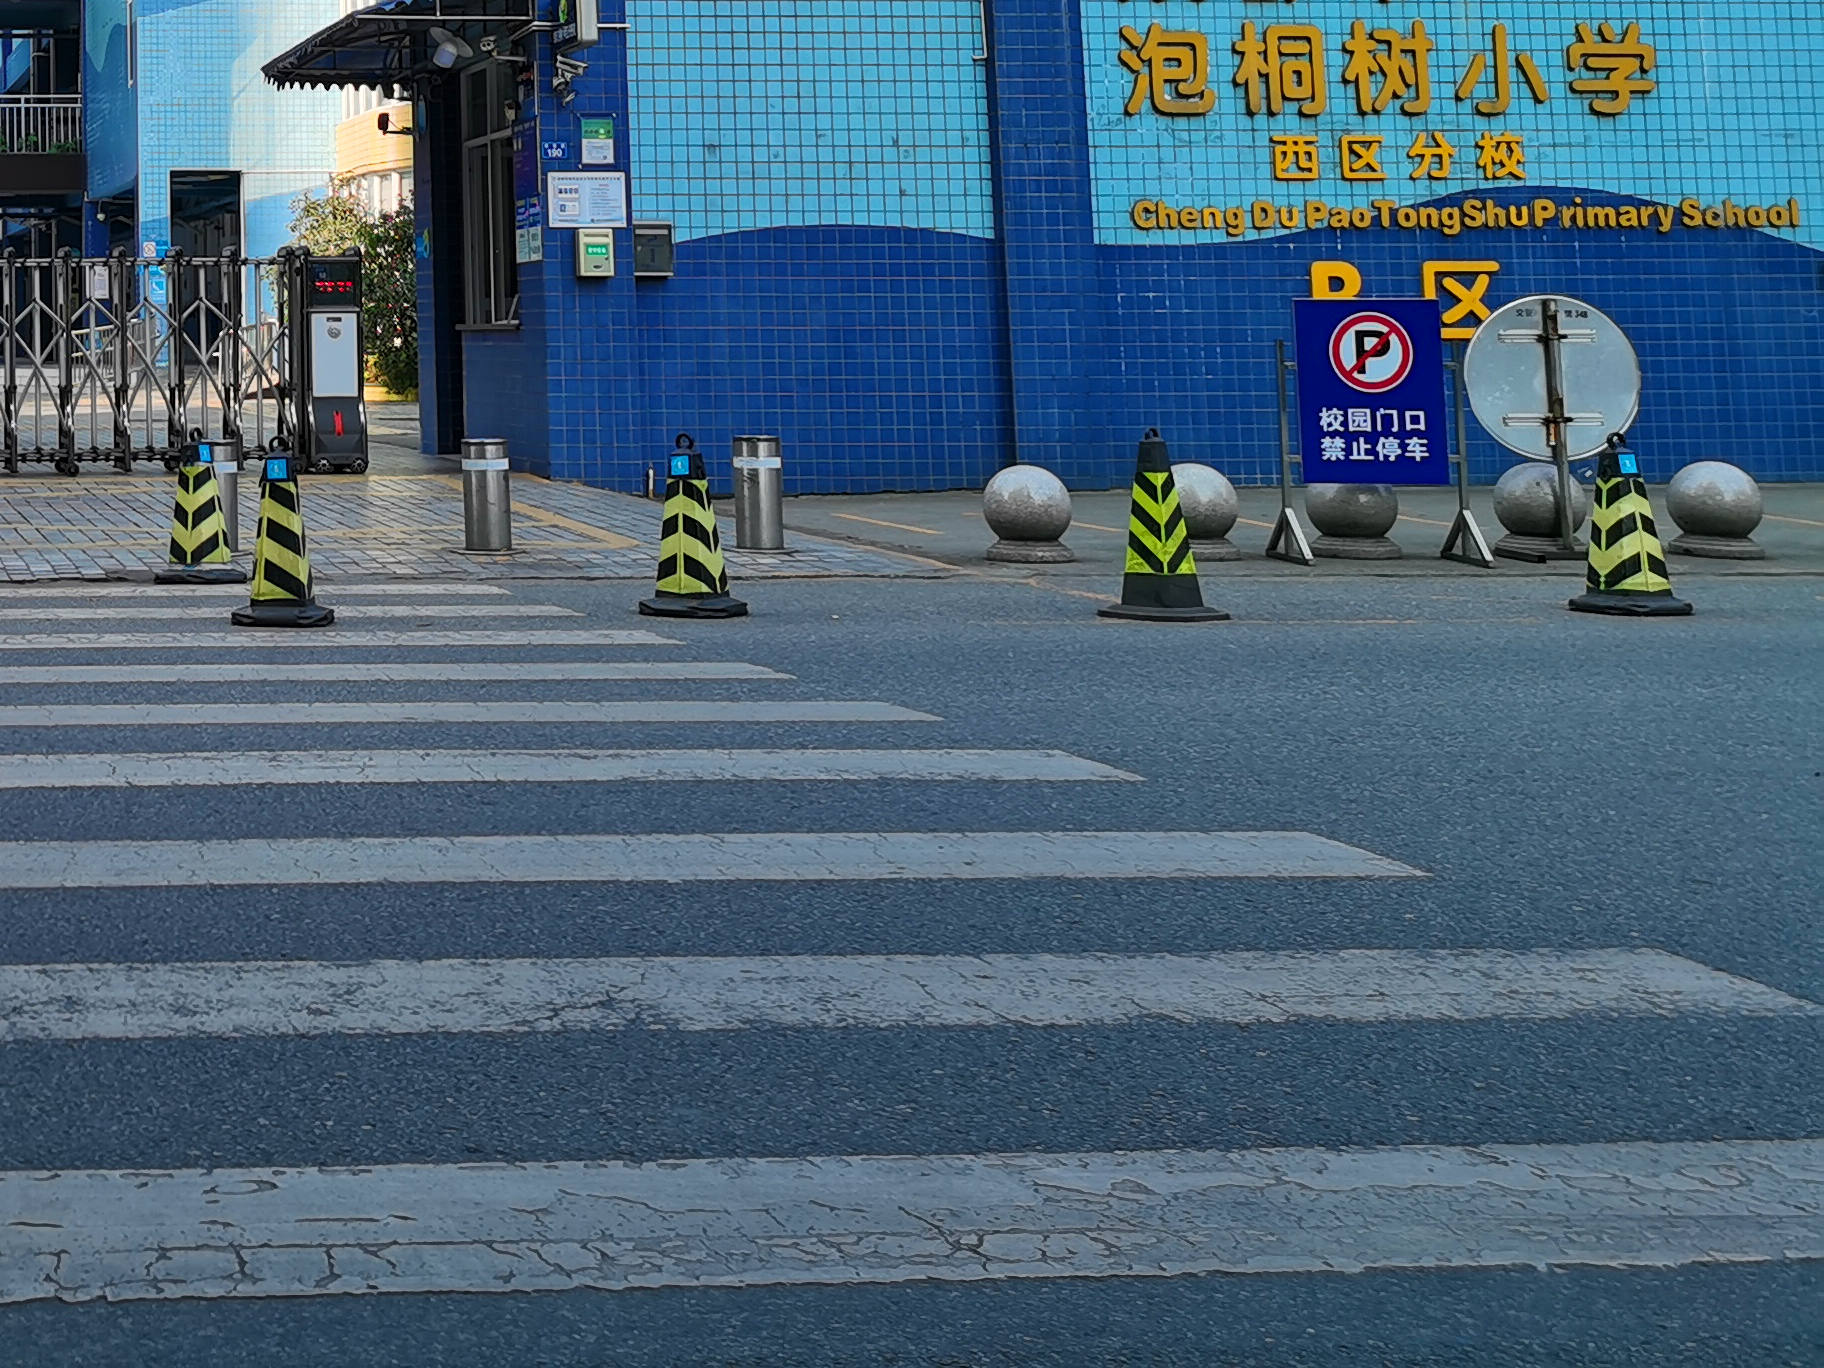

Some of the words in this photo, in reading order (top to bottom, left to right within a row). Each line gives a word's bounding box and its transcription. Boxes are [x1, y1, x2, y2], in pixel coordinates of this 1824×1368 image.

[1118, 19, 1656, 116] 泡桐树小学
[1271, 132, 1526, 181] 西区分校
[1133, 199, 1246, 236] Cheng
[1251, 199, 1299, 229] Du
[1681, 196, 1800, 229] School
[1319, 407, 1426, 432] 校园门口
[1320, 436, 1430, 461] 禁止停车
